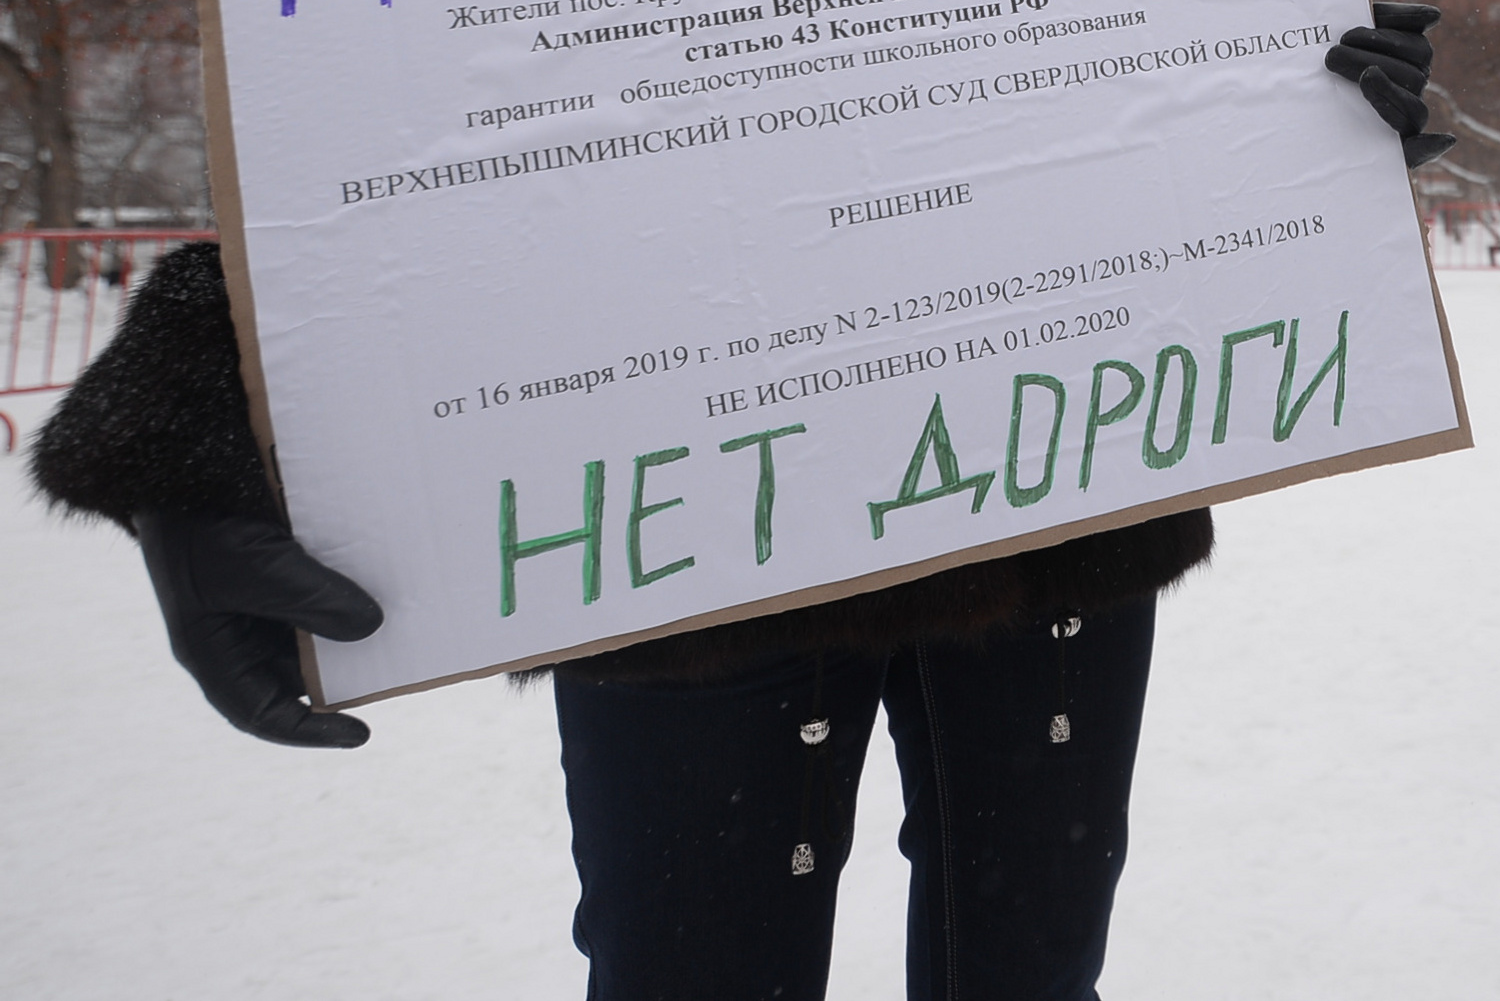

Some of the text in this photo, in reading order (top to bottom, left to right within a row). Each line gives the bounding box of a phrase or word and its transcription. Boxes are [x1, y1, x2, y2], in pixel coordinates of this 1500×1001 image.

[447, 1, 560, 29] Жители
[531, 7, 763, 52] Администрация
[682, 32, 783, 62] статью
[791, 21, 821, 44] 43
[828, 3, 1002, 40] Конституции
[341, 25, 1331, 204] ВЕРХНЕПЫШМИНСКИЙ ГОРОДСКОЙ СУД СВЕРДЛОВСКОЙ ОБЛАСТИ
[466, 5, 1146, 129] гарантии общедоступности школьного образования
[829, 183, 972, 228] РЕШЕНИЕ
[434, 398, 466, 418] от
[478, 382, 509, 409] 16
[520, 367, 615, 401] января
[624, 346, 688, 379] 2019
[698, 347, 718, 363] г.
[727, 338, 759, 357] по
[769, 323, 828, 352] делу
[705, 307, 1129, 417] НЕ ИСПОЛНЕНО НА 01.02.2020
[498, 310, 1349, 617] НЕТ ДОРОГИ
